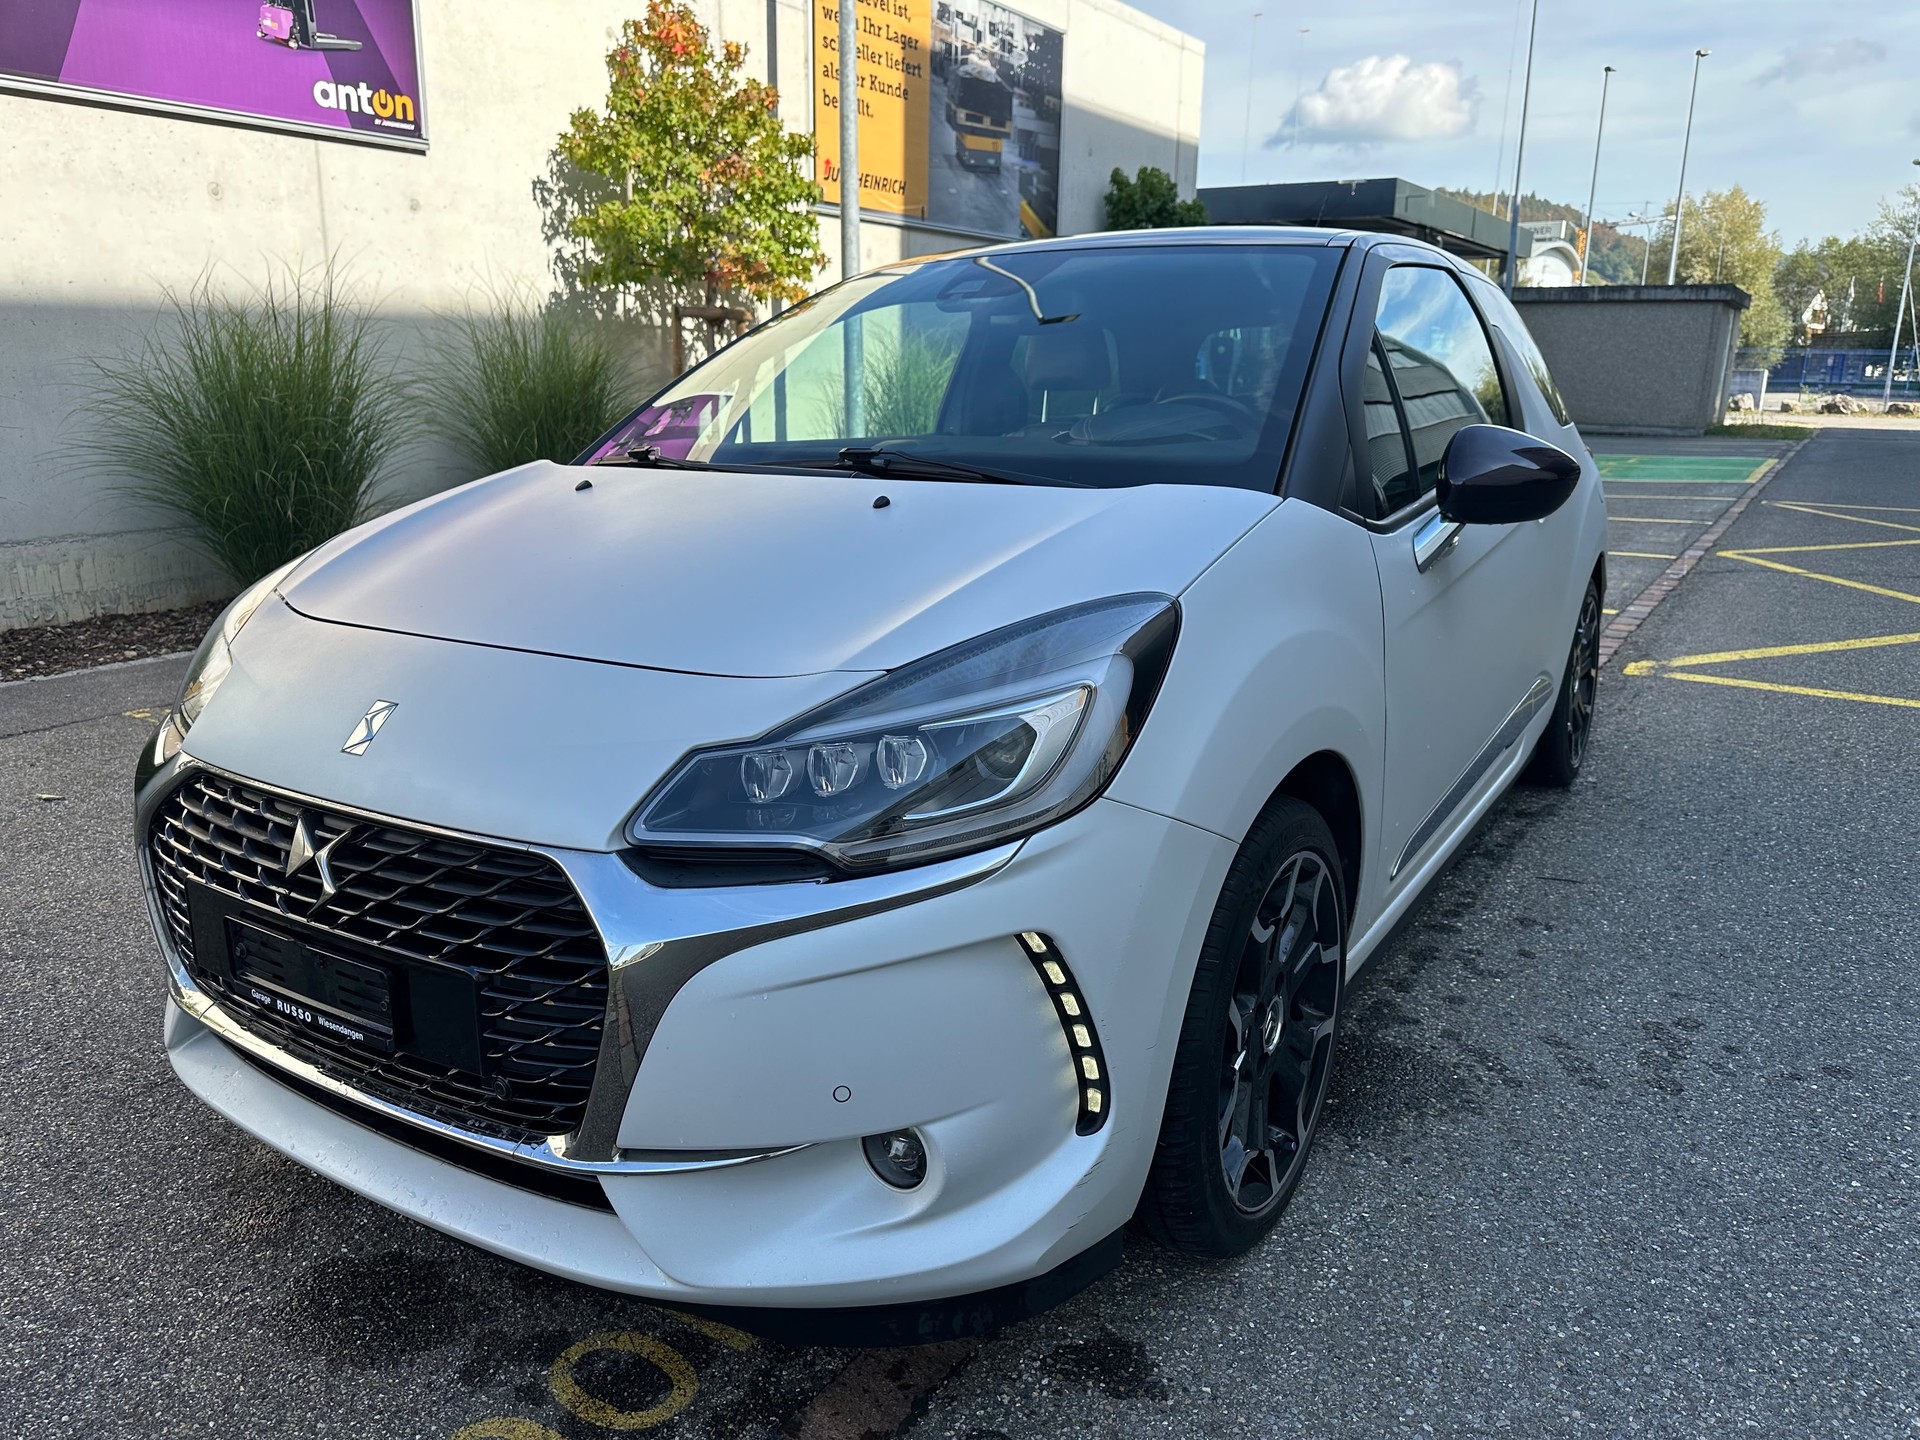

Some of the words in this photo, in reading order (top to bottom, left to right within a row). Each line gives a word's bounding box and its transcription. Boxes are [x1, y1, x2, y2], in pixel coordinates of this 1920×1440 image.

[893, 0, 911, 22] ist,
[863, 16, 882, 37] Ihr
[886, 24, 919, 50] Lager
[885, 51, 922, 78] liefert
[313, 80, 415, 121] anton
[869, 74, 909, 101] Kunde
[823, 166, 907, 196] JUHEINRICH
[251, 988, 271, 1005] Garage
[276, 1000, 312, 1022] RUSSO
[318, 1015, 364, 1041] Wiesendangen
